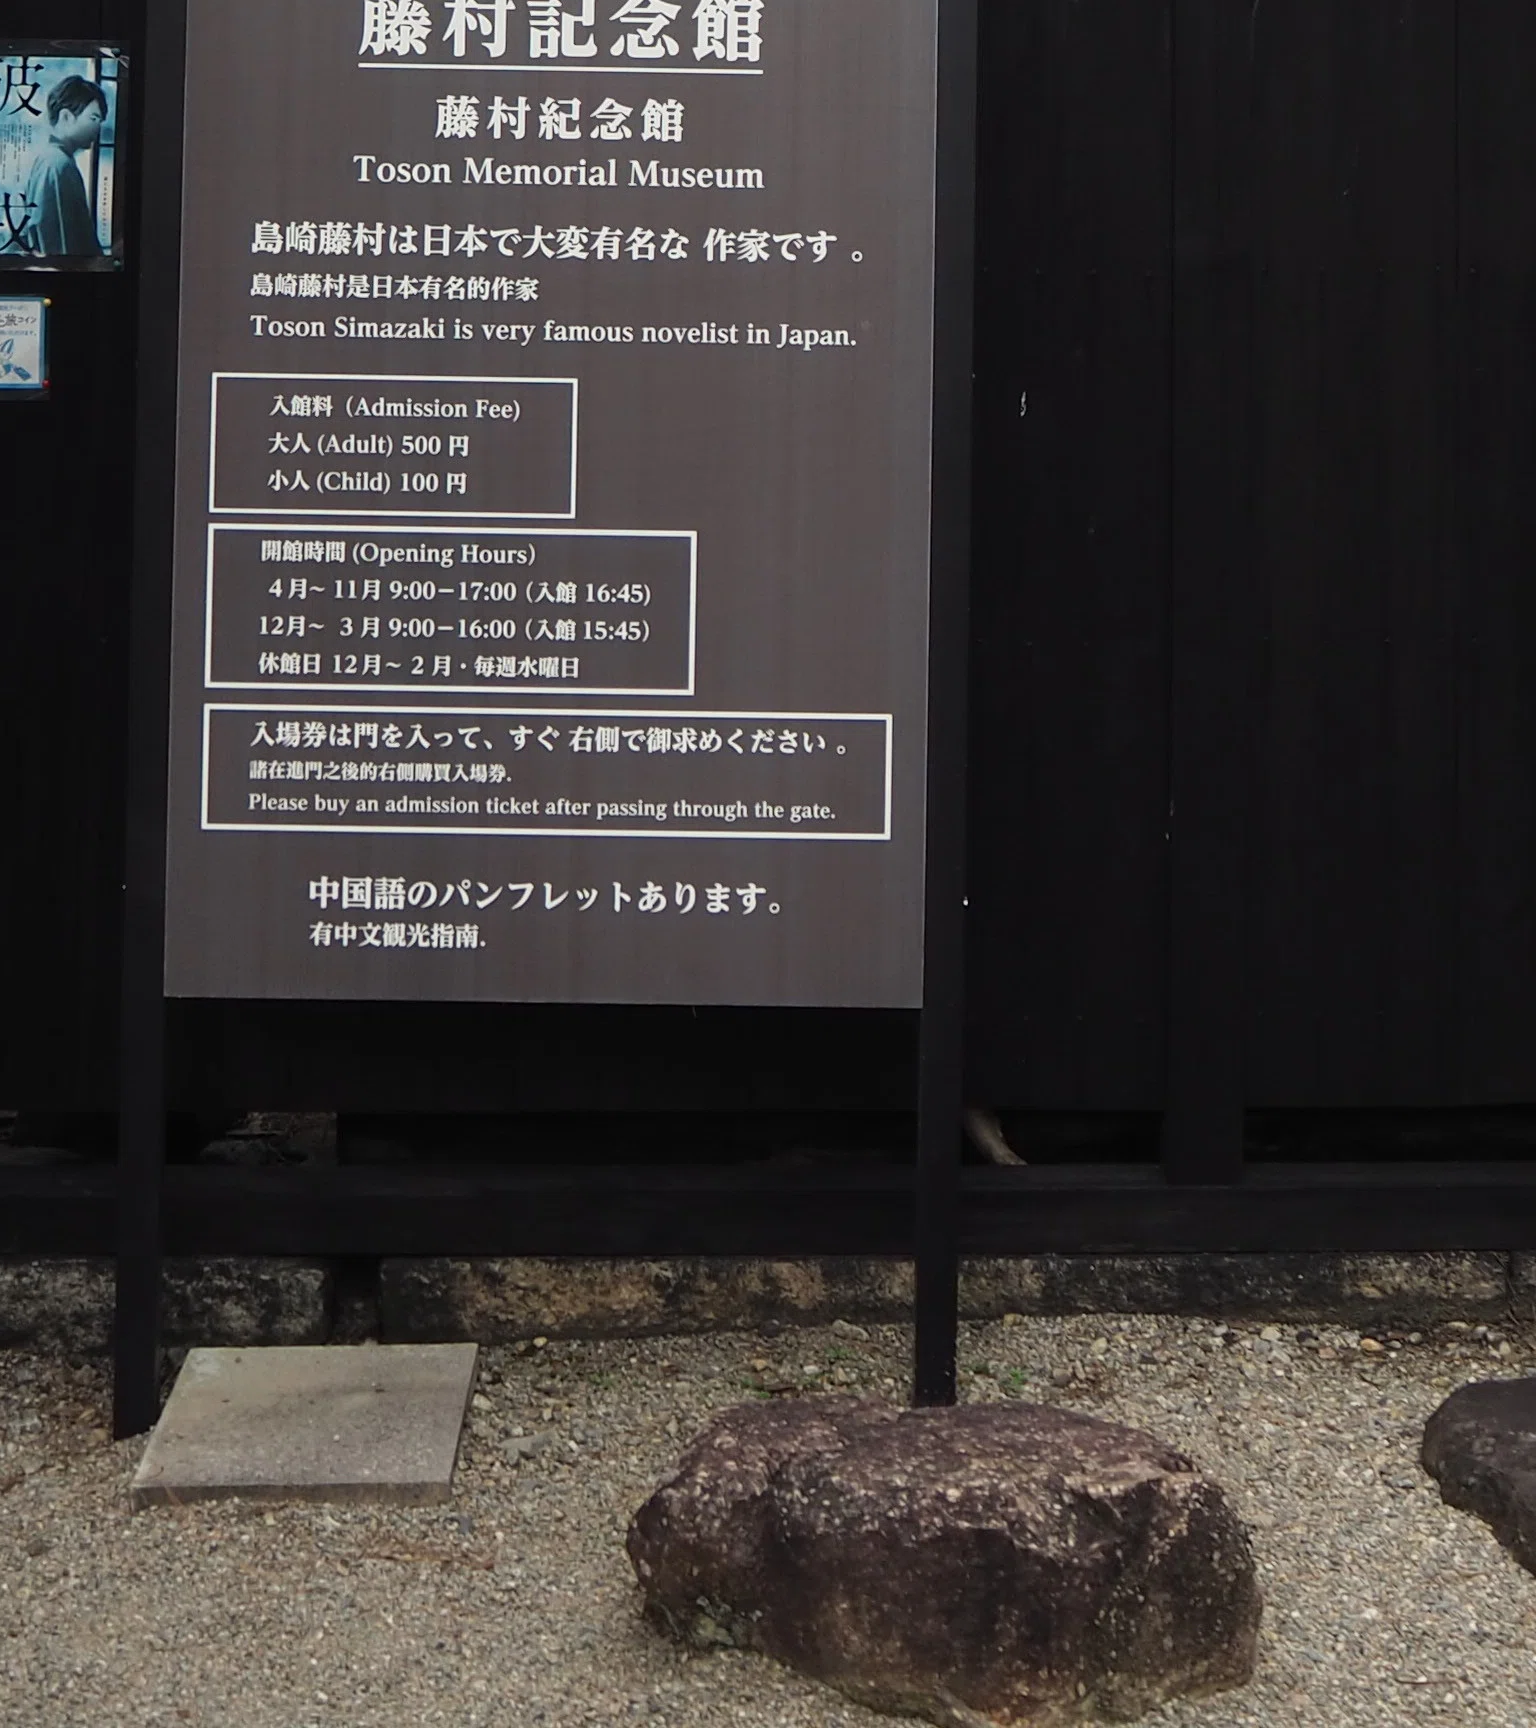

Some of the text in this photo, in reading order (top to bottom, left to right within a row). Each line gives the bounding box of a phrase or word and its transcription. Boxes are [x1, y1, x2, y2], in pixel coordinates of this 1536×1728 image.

[352, 155, 765, 189] Toson Memorial Museum
[249, 314, 857, 352] Toson Simazaki is very famous novelist in Japan.
[475, 399, 521, 423] Fee)
[268, 431, 312, 454] 大人
[317, 433, 393, 458] (Adult)
[400, 435, 442, 455] 500
[267, 469, 311, 492] 小人
[316, 470, 391, 495] (Child)
[401, 472, 439, 493] 100
[261, 539, 536, 569] 開館時間 (Opening Hours)
[586, 583, 651, 607] 16:45)
[583, 619, 650, 643] 15:45)
[258, 651, 321, 675] 休館日
[248, 792, 836, 823] Please buy an admission ticket after passing through the gate.
